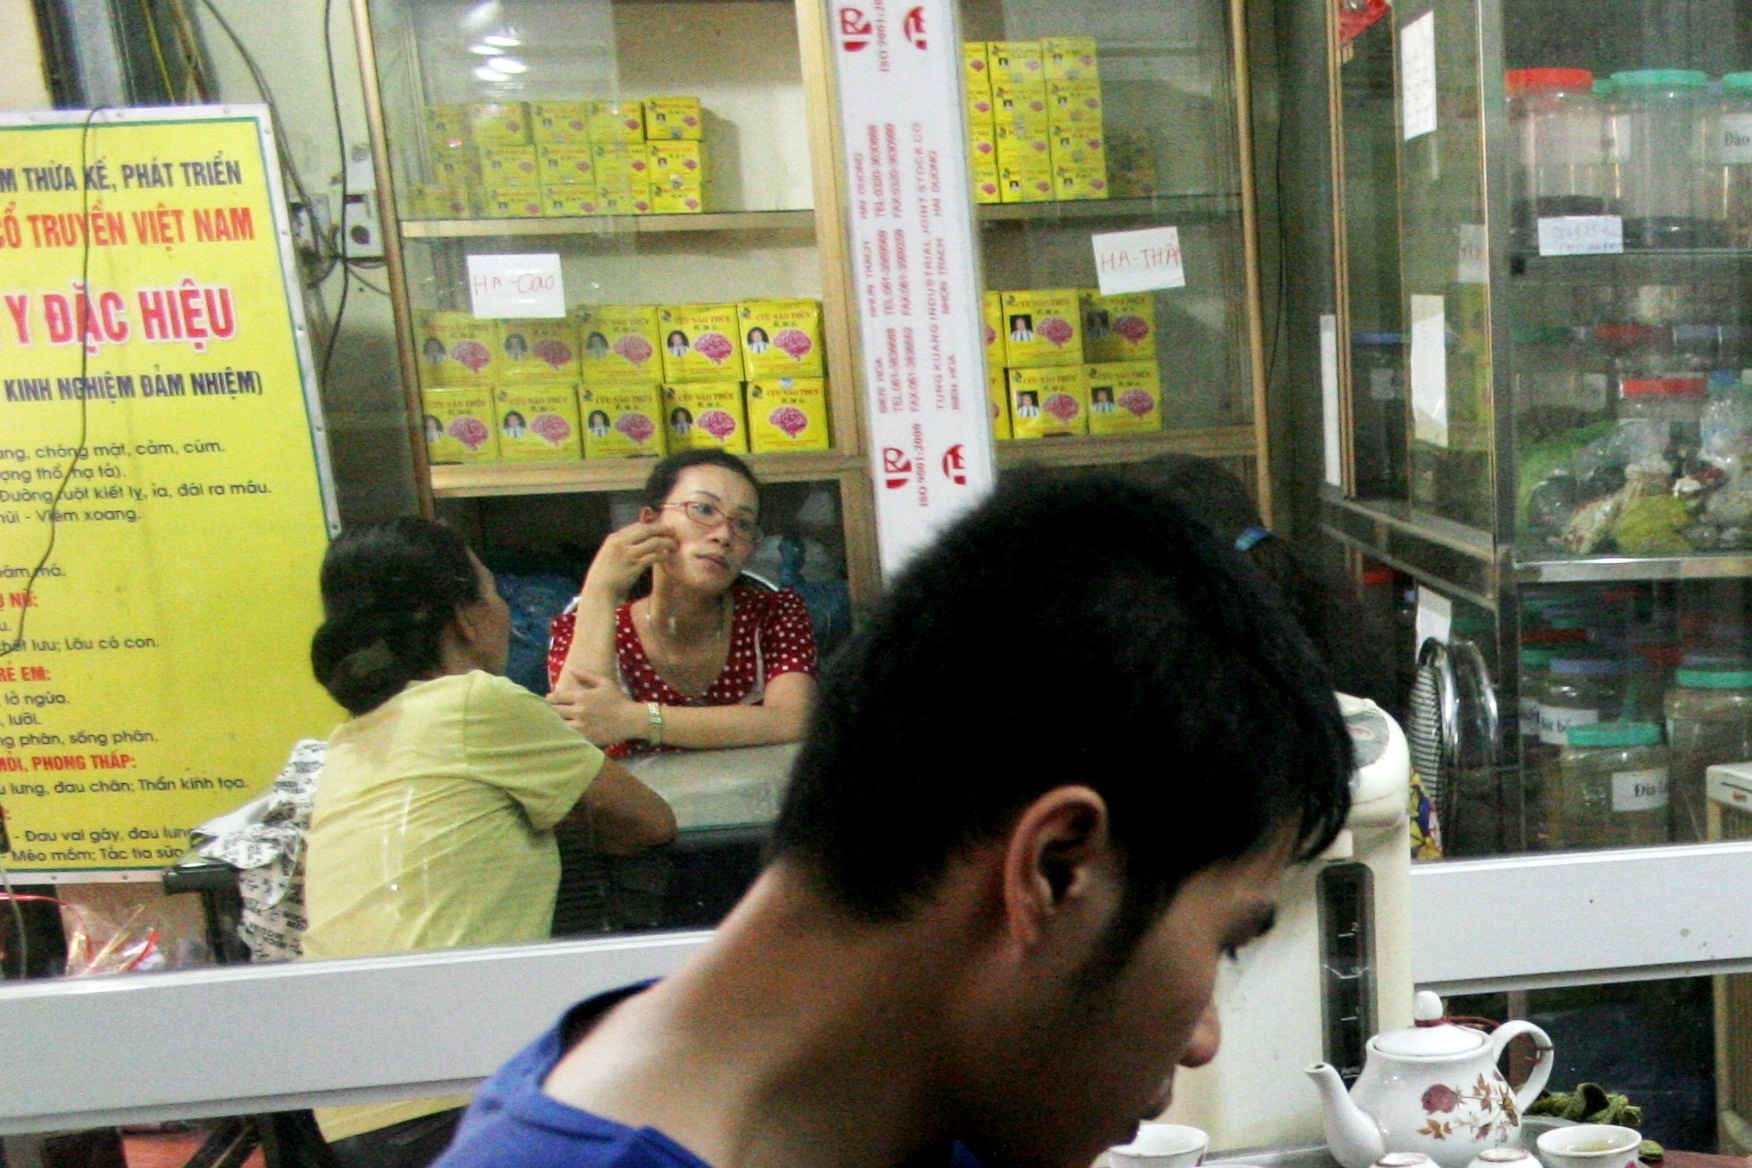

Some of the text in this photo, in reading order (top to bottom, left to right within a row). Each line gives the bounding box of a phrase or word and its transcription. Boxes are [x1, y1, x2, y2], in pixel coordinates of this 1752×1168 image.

[122, 156, 174, 189] PHÁT
[184, 151, 242, 187] TRIỂN
[27, 200, 128, 248] TRUYỀN
[132, 202, 187, 252] VIỆT
[193, 206, 256, 243] NAM
[43, 281, 130, 354] ĐẶC
[137, 278, 235, 351] HIỆU
[4, 378, 53, 401] KINH
[57, 371, 137, 404] NGHIỆM
[208, 484, 227, 496] ra
[230, 480, 273, 495] máu.
[84, 509, 141, 523] xoang.
[124, 637, 160, 650] con.
[32, 754, 86, 772] PHONG
[54, 780, 85, 794] đau
[180, 776, 214, 790] kinh
[128, 826, 160, 841] đau
